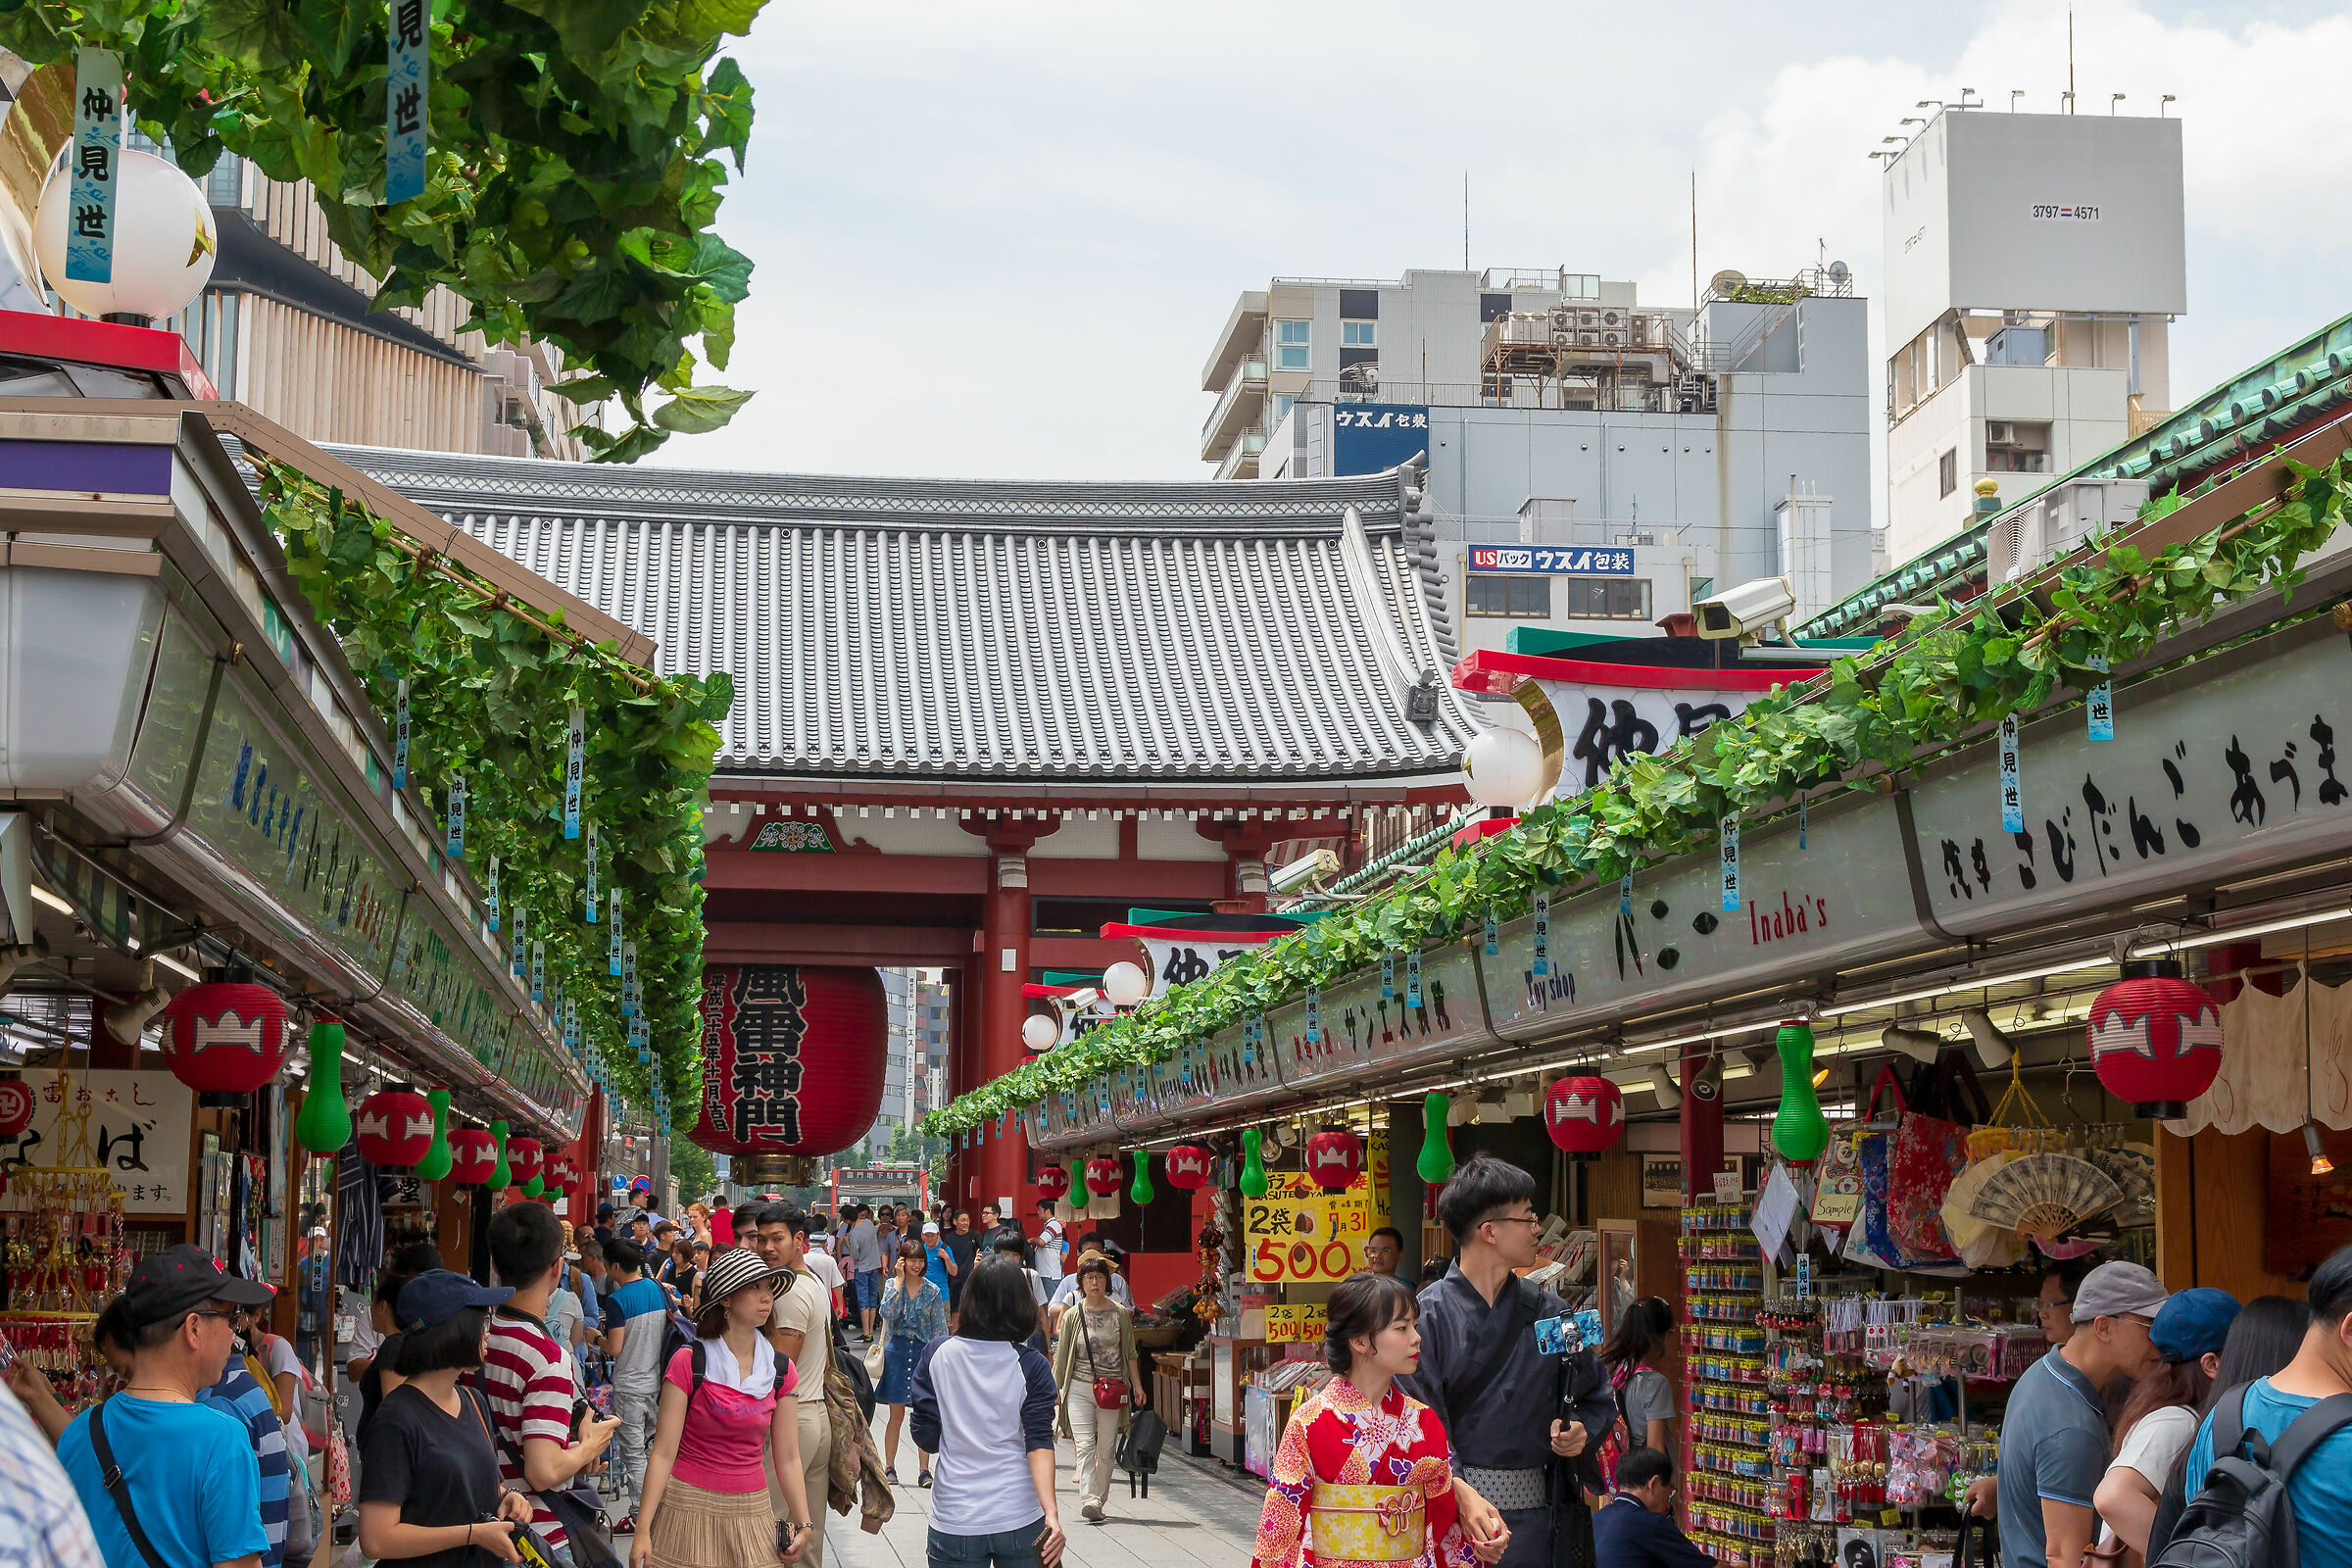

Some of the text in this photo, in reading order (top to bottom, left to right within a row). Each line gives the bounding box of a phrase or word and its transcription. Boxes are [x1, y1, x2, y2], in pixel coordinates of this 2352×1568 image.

[75, 87, 113, 239] 仲見世
[1336, 411, 1428, 429] ウスイ包装
[1475, 551, 1630, 570] US パック ウスイ包装
[397, 695, 407, 766] 仲見世
[567, 729, 582, 812] 仲見世
[2002, 717, 2019, 808] 仲見世
[2225, 713, 2349, 829] あづま
[451, 780, 462, 840] 仲見世
[1723, 818, 1738, 891] 仲見世
[1536, 899, 1546, 958] 仲見世
[1749, 891, 1828, 946] Inaba's
[514, 919, 524, 964] 仲見世
[534, 952, 543, 991] 仲見世
[624, 954, 634, 1001] 仲見世
[1383, 951, 1392, 985] 見世
[1550, 961, 1576, 1004] shop
[1307, 986, 1317, 1029] 仲見世
[729, 965, 808, 1145] 風雷神門
[1249, 1205, 1293, 1235] 2袋
[1817, 1199, 1853, 1217] Sample
[313, 1252, 322, 1292] 仲見世
[1253, 1238, 1351, 1282] 500
[1799, 1257, 1808, 1297] 仲見世
